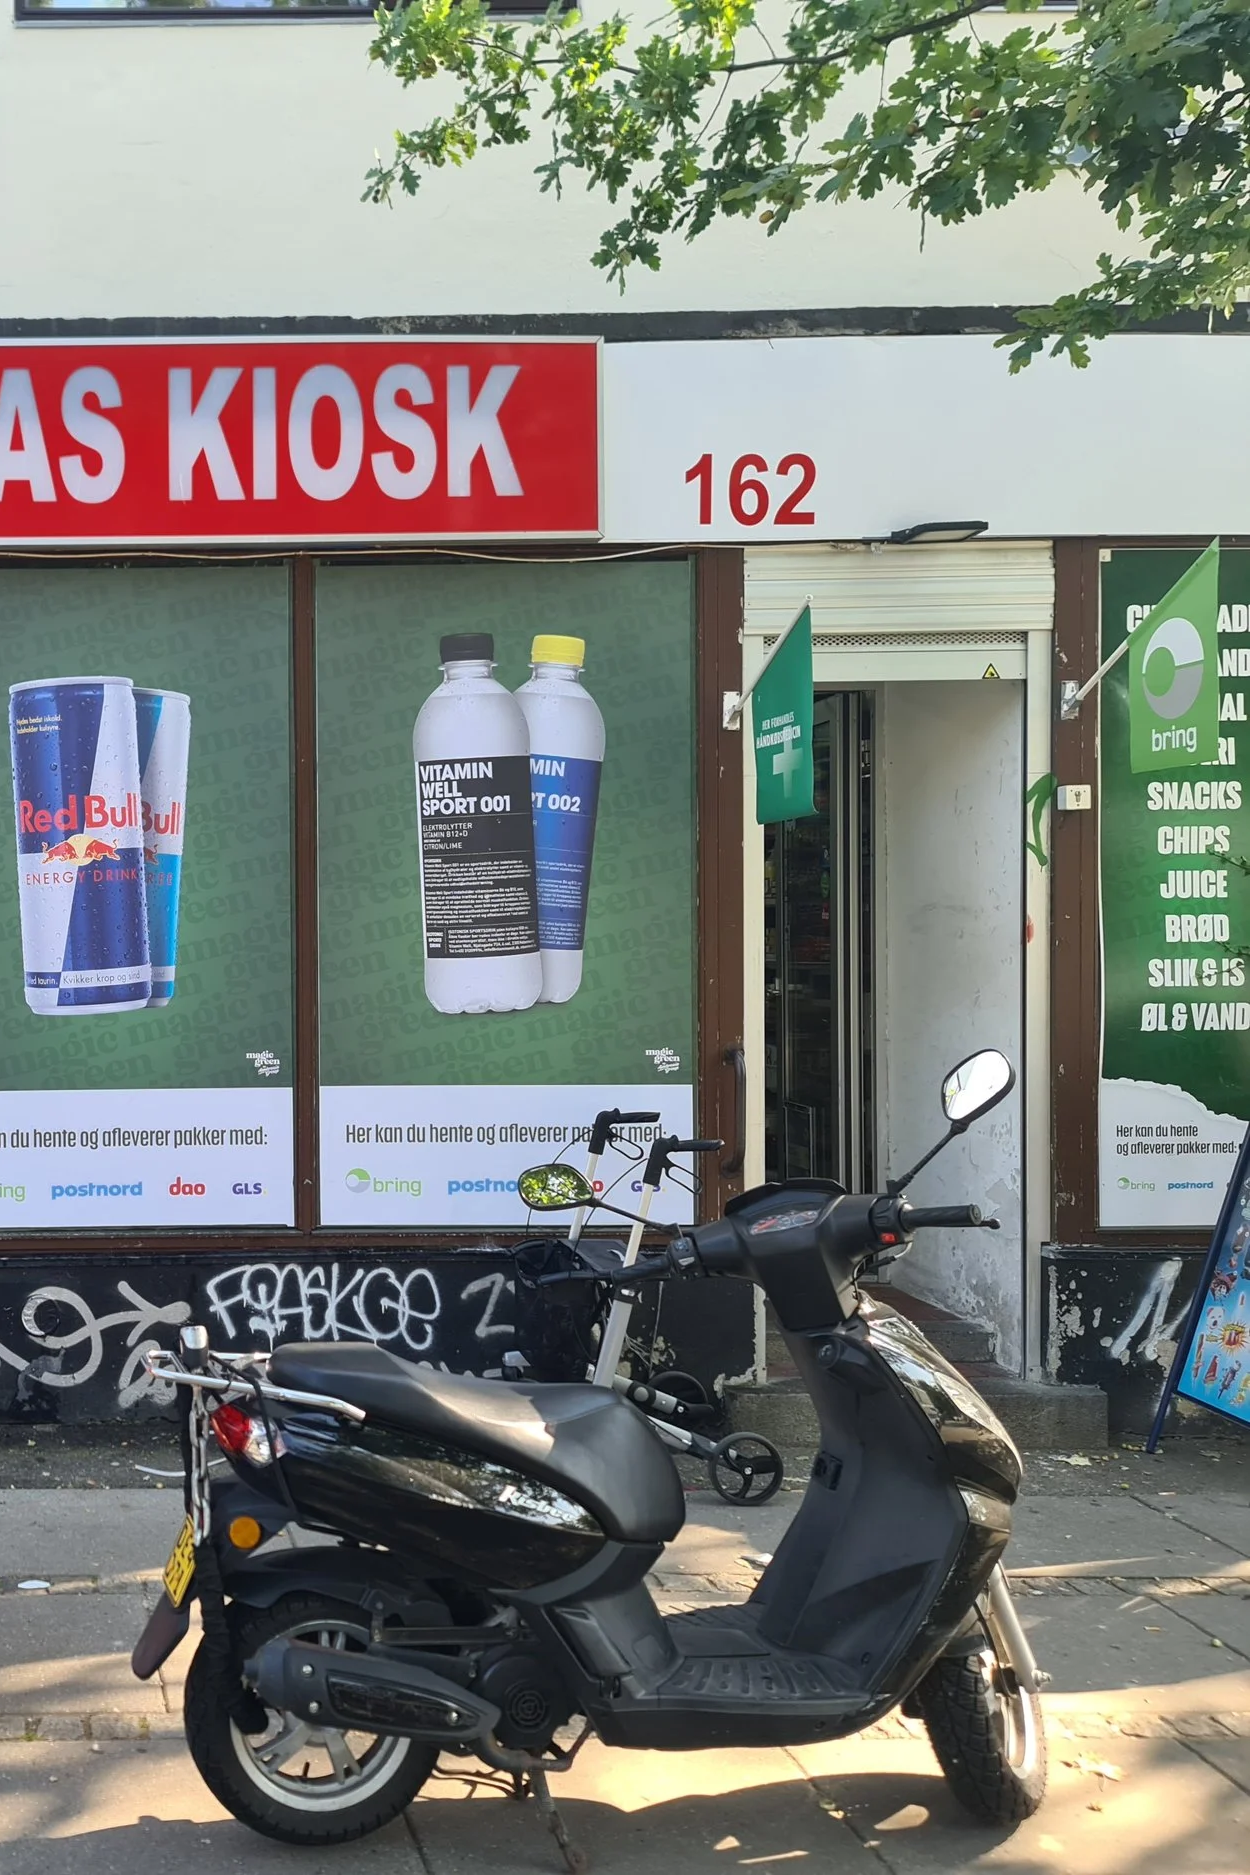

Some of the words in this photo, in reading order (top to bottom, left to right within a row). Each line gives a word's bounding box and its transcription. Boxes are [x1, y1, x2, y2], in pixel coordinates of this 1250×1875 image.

[167, 363, 523, 501] KIOSK
[685, 452, 817, 527] 162
[1152, 725, 1197, 753] bring
[420, 761, 493, 782] VITAMIN
[421, 781, 462, 799] WELL
[1147, 781, 1242, 811] SNACKS
[18, 794, 78, 833] Red
[84, 792, 139, 829] Bull
[422, 796, 477, 816] SPORT
[480, 795, 511, 813] 001
[548, 796, 581, 813] 002
[423, 822, 472, 832] ELEKTROLYTTER
[423, 842, 463, 851] CITRON/LIME
[1157, 825, 1230, 855] CHIPS
[26, 871, 86, 886] ENERGY
[93, 868, 138, 882] DRINK
[1160, 870, 1228, 899] JUICE
[1165, 914, 1230, 943] BRØD
[63, 975, 94, 985] Kvikker
[95, 974, 115, 985] krop
[117, 974, 127, 983] og
[1148, 958, 1199, 987] SLIK
[1201, 958, 1218, 987] &
[1222, 957, 1245, 987] IS
[1140, 1003, 1168, 1032] ØL
[1171, 1003, 1187, 1031] &
[1191, 1003, 1250, 1031] VAND
[246, 1050, 274, 1060] magic
[254, 1057, 280, 1067] green
[645, 1047, 673, 1057] magic
[654, 1055, 680, 1064] green
[10, 1128, 30, 1149] du
[33, 1128, 76, 1148] hente
[80, 1127, 99, 1150] og
[102, 1127, 171, 1147] afleverer
[174, 1127, 226, 1149] pakker
[229, 1126, 268, 1146] med:
[346, 1124, 372, 1143] Her
[375, 1123, 403, 1143] kan
[406, 1123, 426, 1143] du
[429, 1123, 473, 1143] hente
[477, 1122, 496, 1145] og
[499, 1122, 568, 1143] afleverer
[572, 1123, 625, 1145] paer
[1116, 1125, 1134, 1138] Her
[1135, 1125, 1153, 1138] kan
[1155, 1124, 1168, 1137] du
[1170, 1124, 1198, 1137] hente
[1116, 1141, 1128, 1156] og
[1131, 1141, 1175, 1155] afleverer
[1177, 1141, 1210, 1156] pakker
[1212, 1141, 1237, 1154] med:
[51, 1181, 143, 1200] postnord
[169, 1176, 206, 1196] dao
[232, 1183, 262, 1195] GLS
[373, 1178, 421, 1196] bring
[447, 1178, 519, 1195] postno
[1130, 1181, 1156, 1192] bring
[1167, 1181, 1214, 1191] postnord
